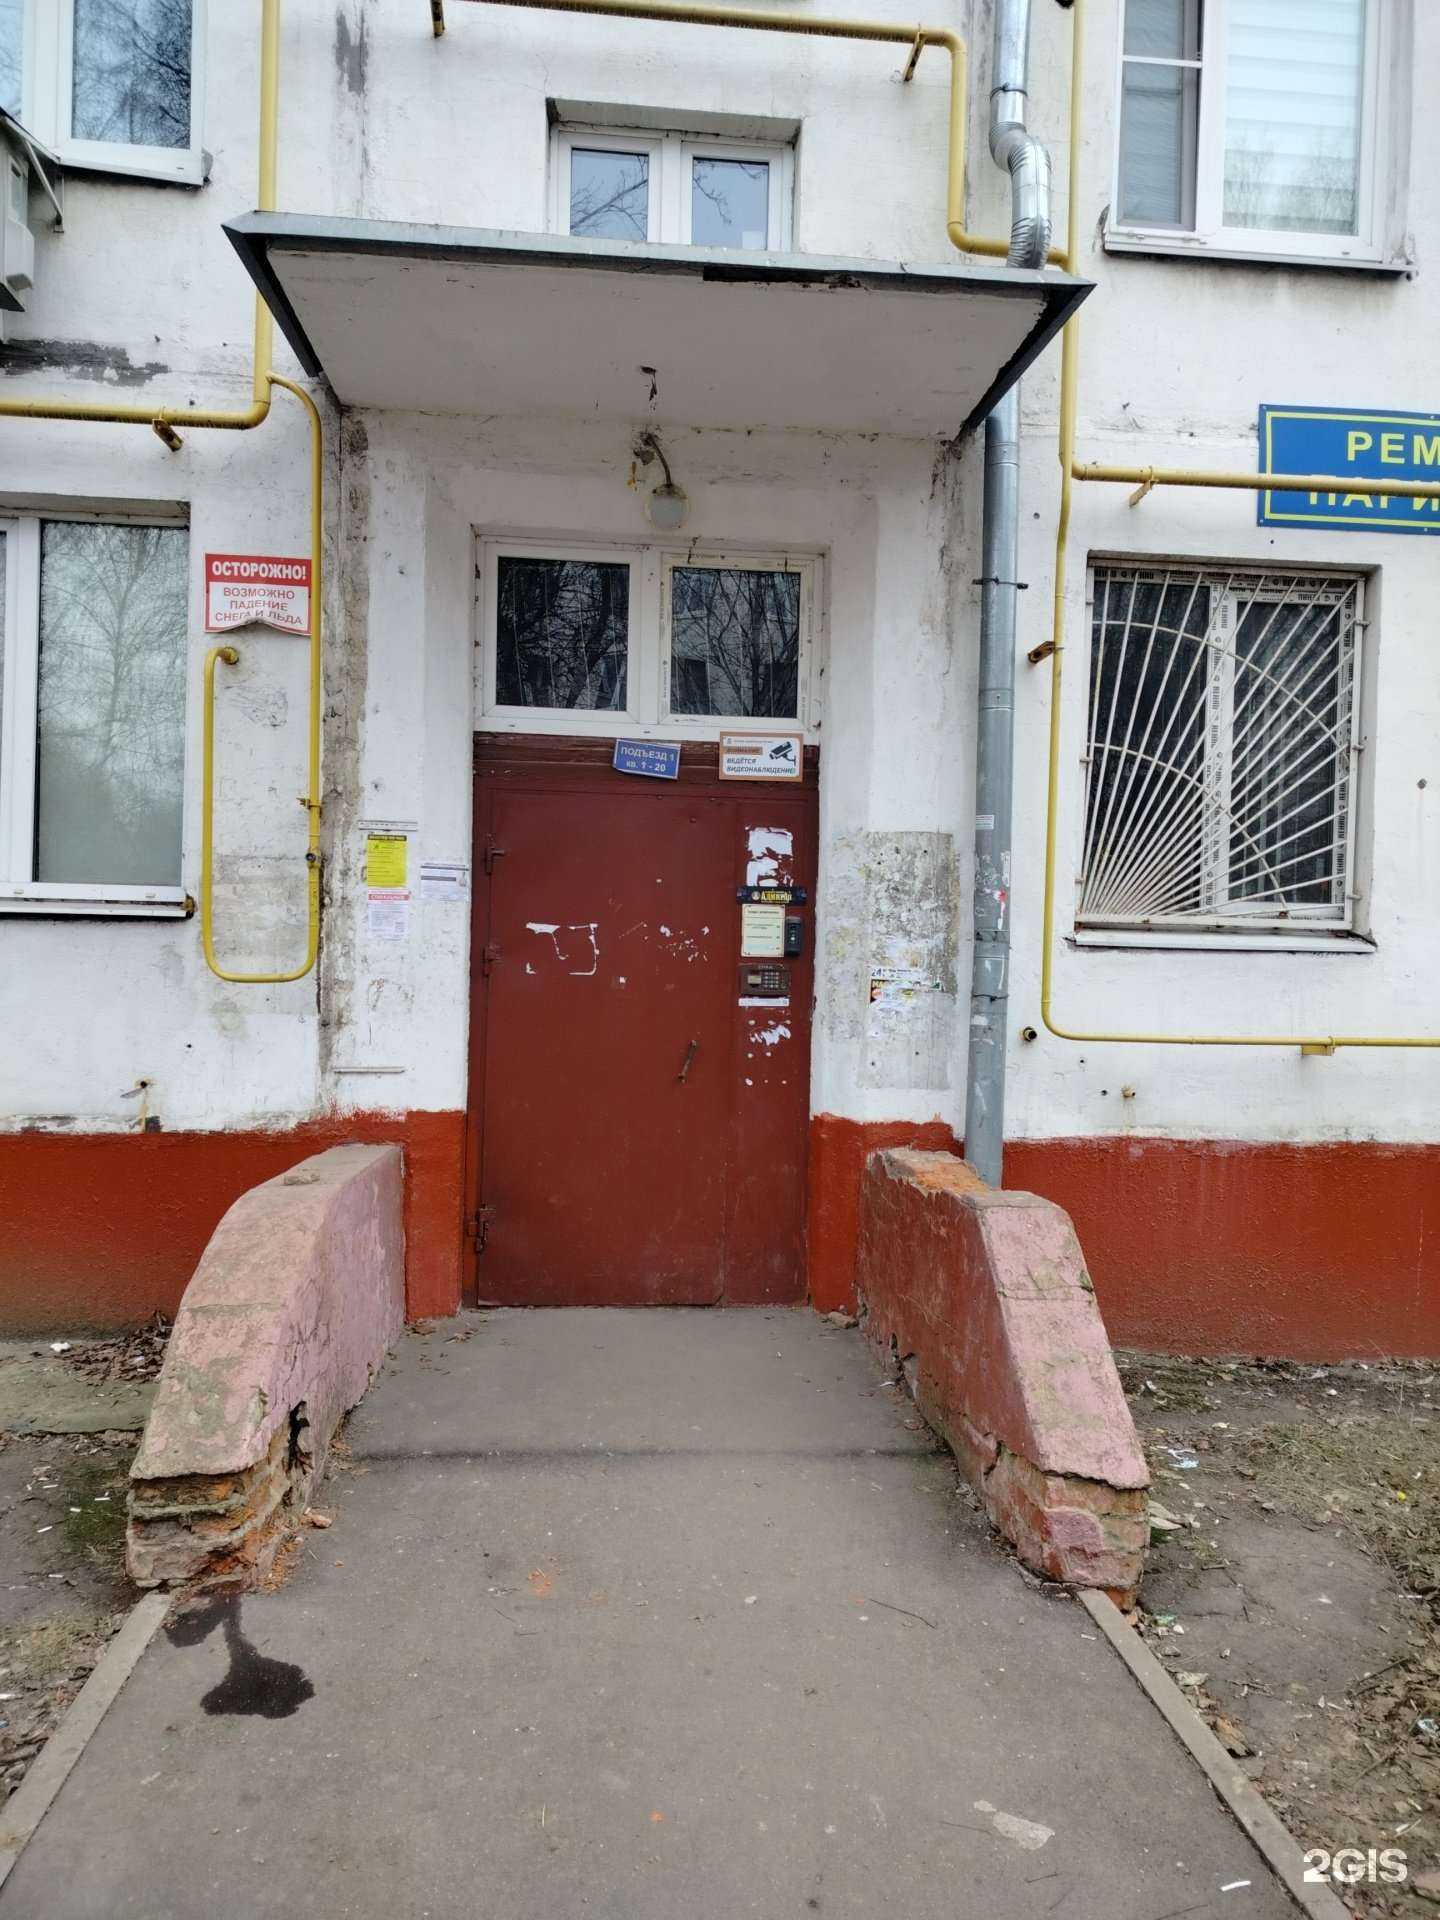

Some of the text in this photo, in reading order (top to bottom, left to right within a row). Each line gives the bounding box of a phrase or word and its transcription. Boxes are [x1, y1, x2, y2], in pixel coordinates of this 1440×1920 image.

[212, 561, 306, 580] ОСТОРОЖНО!
[223, 587, 295, 600] ВОЗМОЖНО
[230, 600, 288, 611] ПАДЕНИЕ
[215, 612, 250, 622] СНЕГА
[267, 611, 303, 625] ЛЬДА
[621, 746, 667, 761] ПОДЪЕЗД
[655, 763, 666, 772] 20
